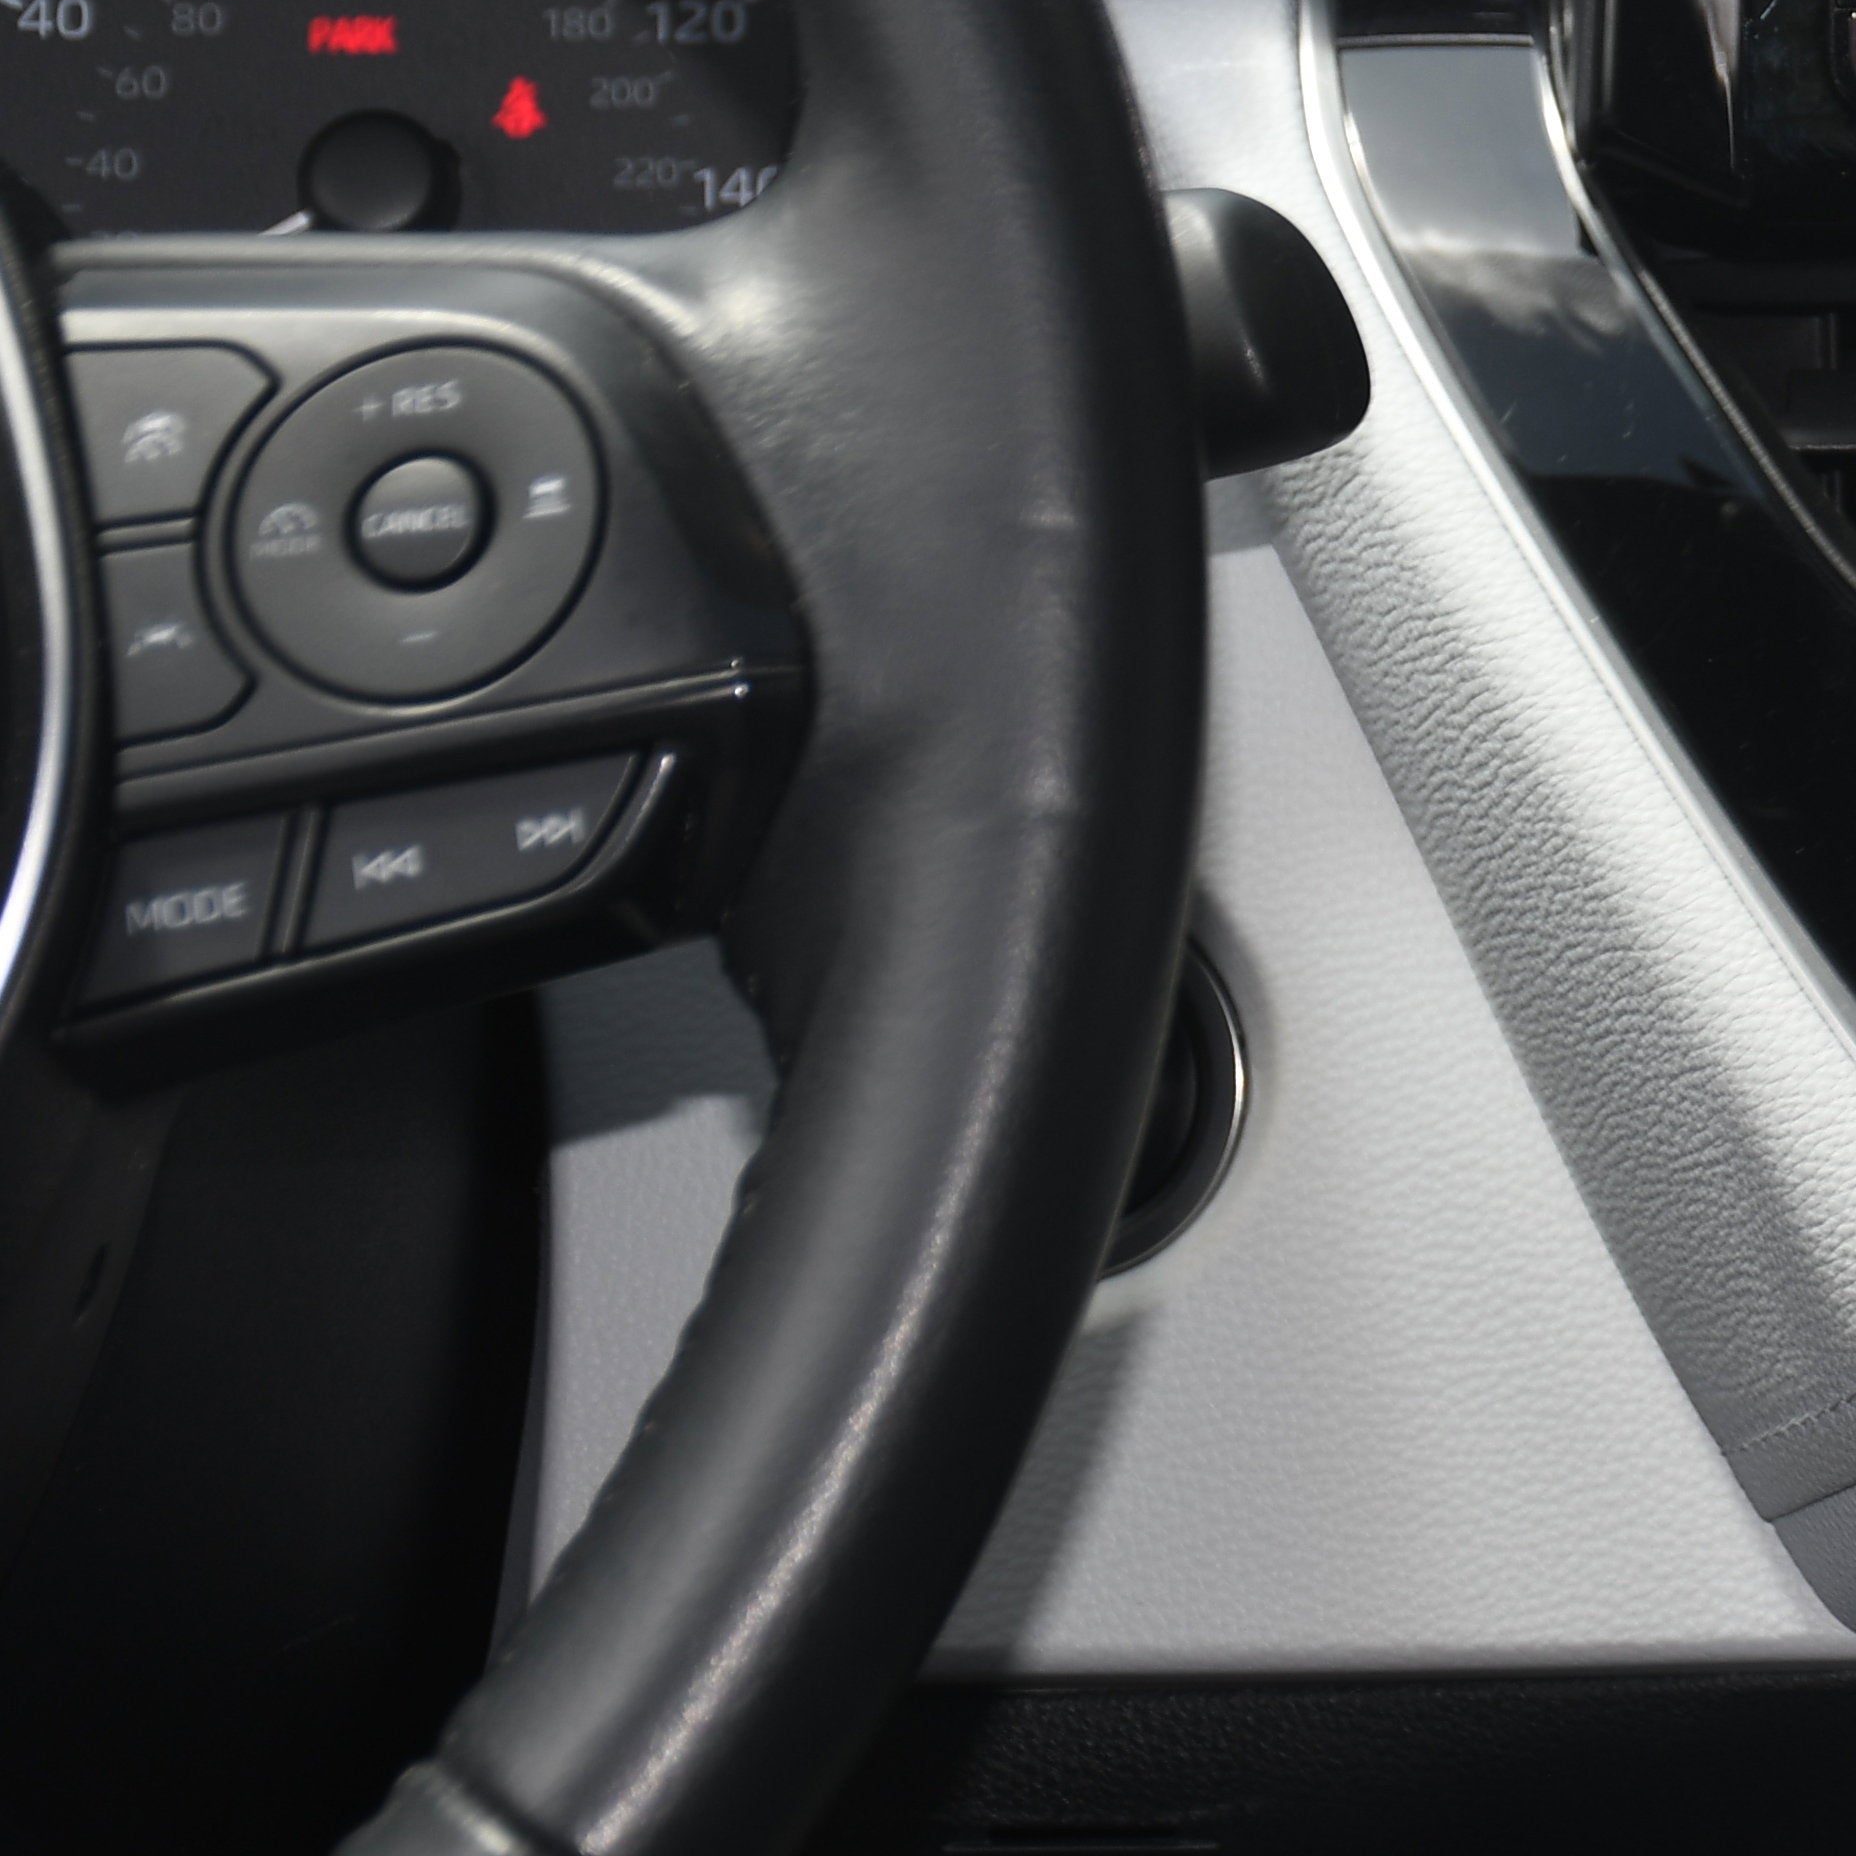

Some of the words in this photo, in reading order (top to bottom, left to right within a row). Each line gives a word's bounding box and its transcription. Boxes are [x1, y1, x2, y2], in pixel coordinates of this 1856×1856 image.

[171, 3, 221, 34] 80
[545, 7, 613, 39] 180
[308, 16, 398, 55] PARK
[114, 66, 167, 98] 60
[589, 76, 655, 109] 200
[85, 150, 138, 180] 40
[613, 156, 679, 189] 220
[392, 382, 462, 416] RES
[362, 503, 468, 537] CANCEL
[126, 882, 249, 937] MODE
